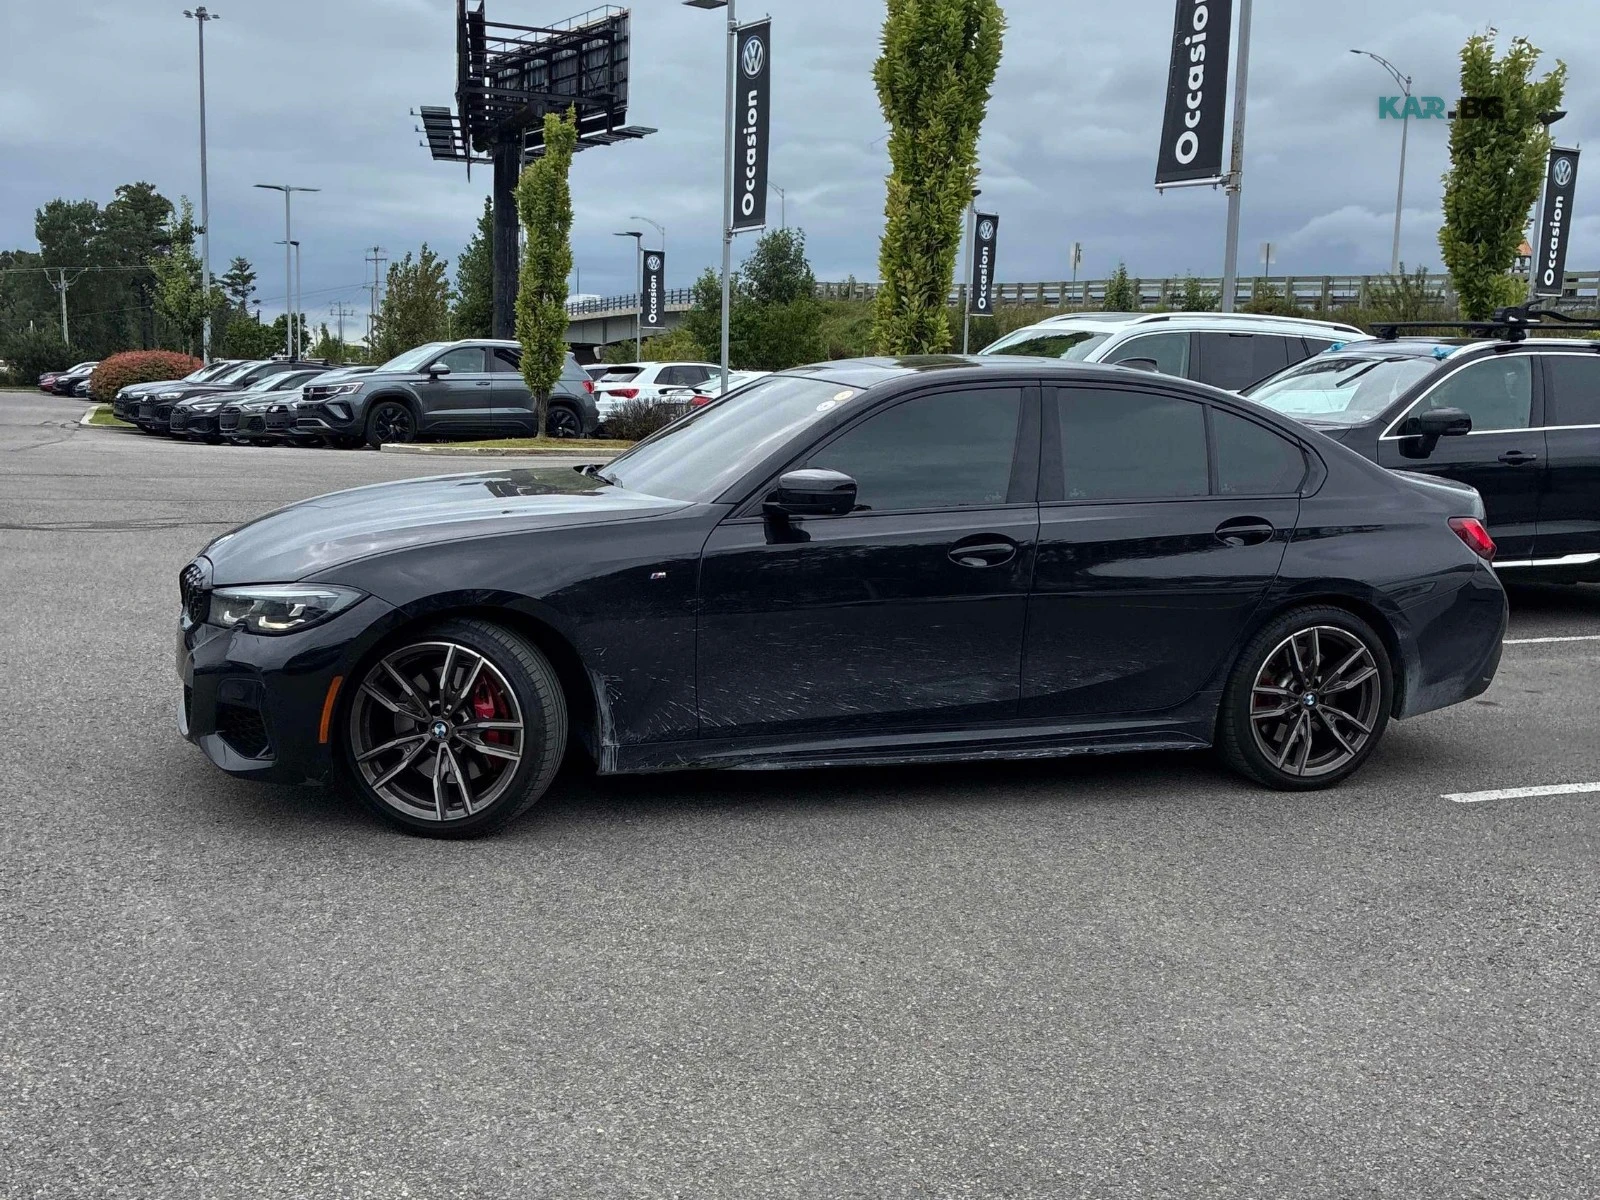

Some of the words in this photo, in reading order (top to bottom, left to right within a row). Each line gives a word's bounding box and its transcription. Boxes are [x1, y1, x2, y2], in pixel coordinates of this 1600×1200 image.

[742, 36, 765, 79] VW
[1175, 0, 1209, 165] Occasio
[742, 89, 758, 216] Occasion
[978, 246, 989, 309] Occasion
[1544, 196, 1564, 286] Occasion
[648, 275, 657, 323] Occasion
